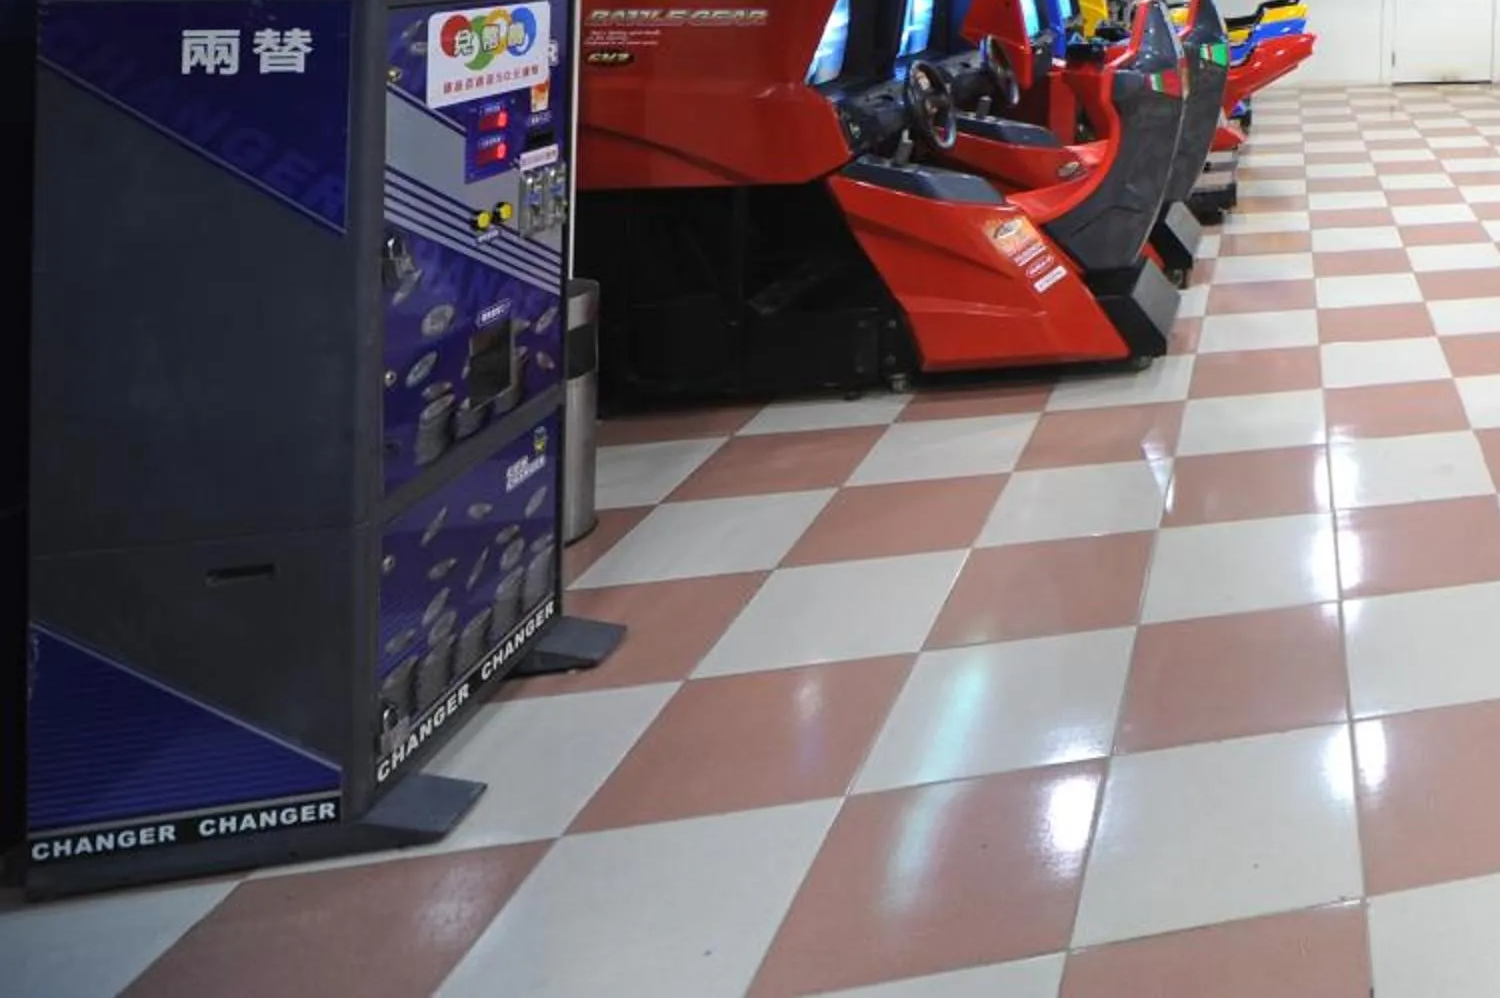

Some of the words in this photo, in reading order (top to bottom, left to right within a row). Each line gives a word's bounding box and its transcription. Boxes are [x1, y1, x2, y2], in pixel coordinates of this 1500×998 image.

[689, 8, 768, 26] GEAR
[181, 27, 315, 75] 兩替
[376, 682, 471, 783] CHANGER
[480, 601, 555, 681] CHANGER
[31, 824, 177, 861] CHANGER
[198, 801, 336, 836] CHANGER
